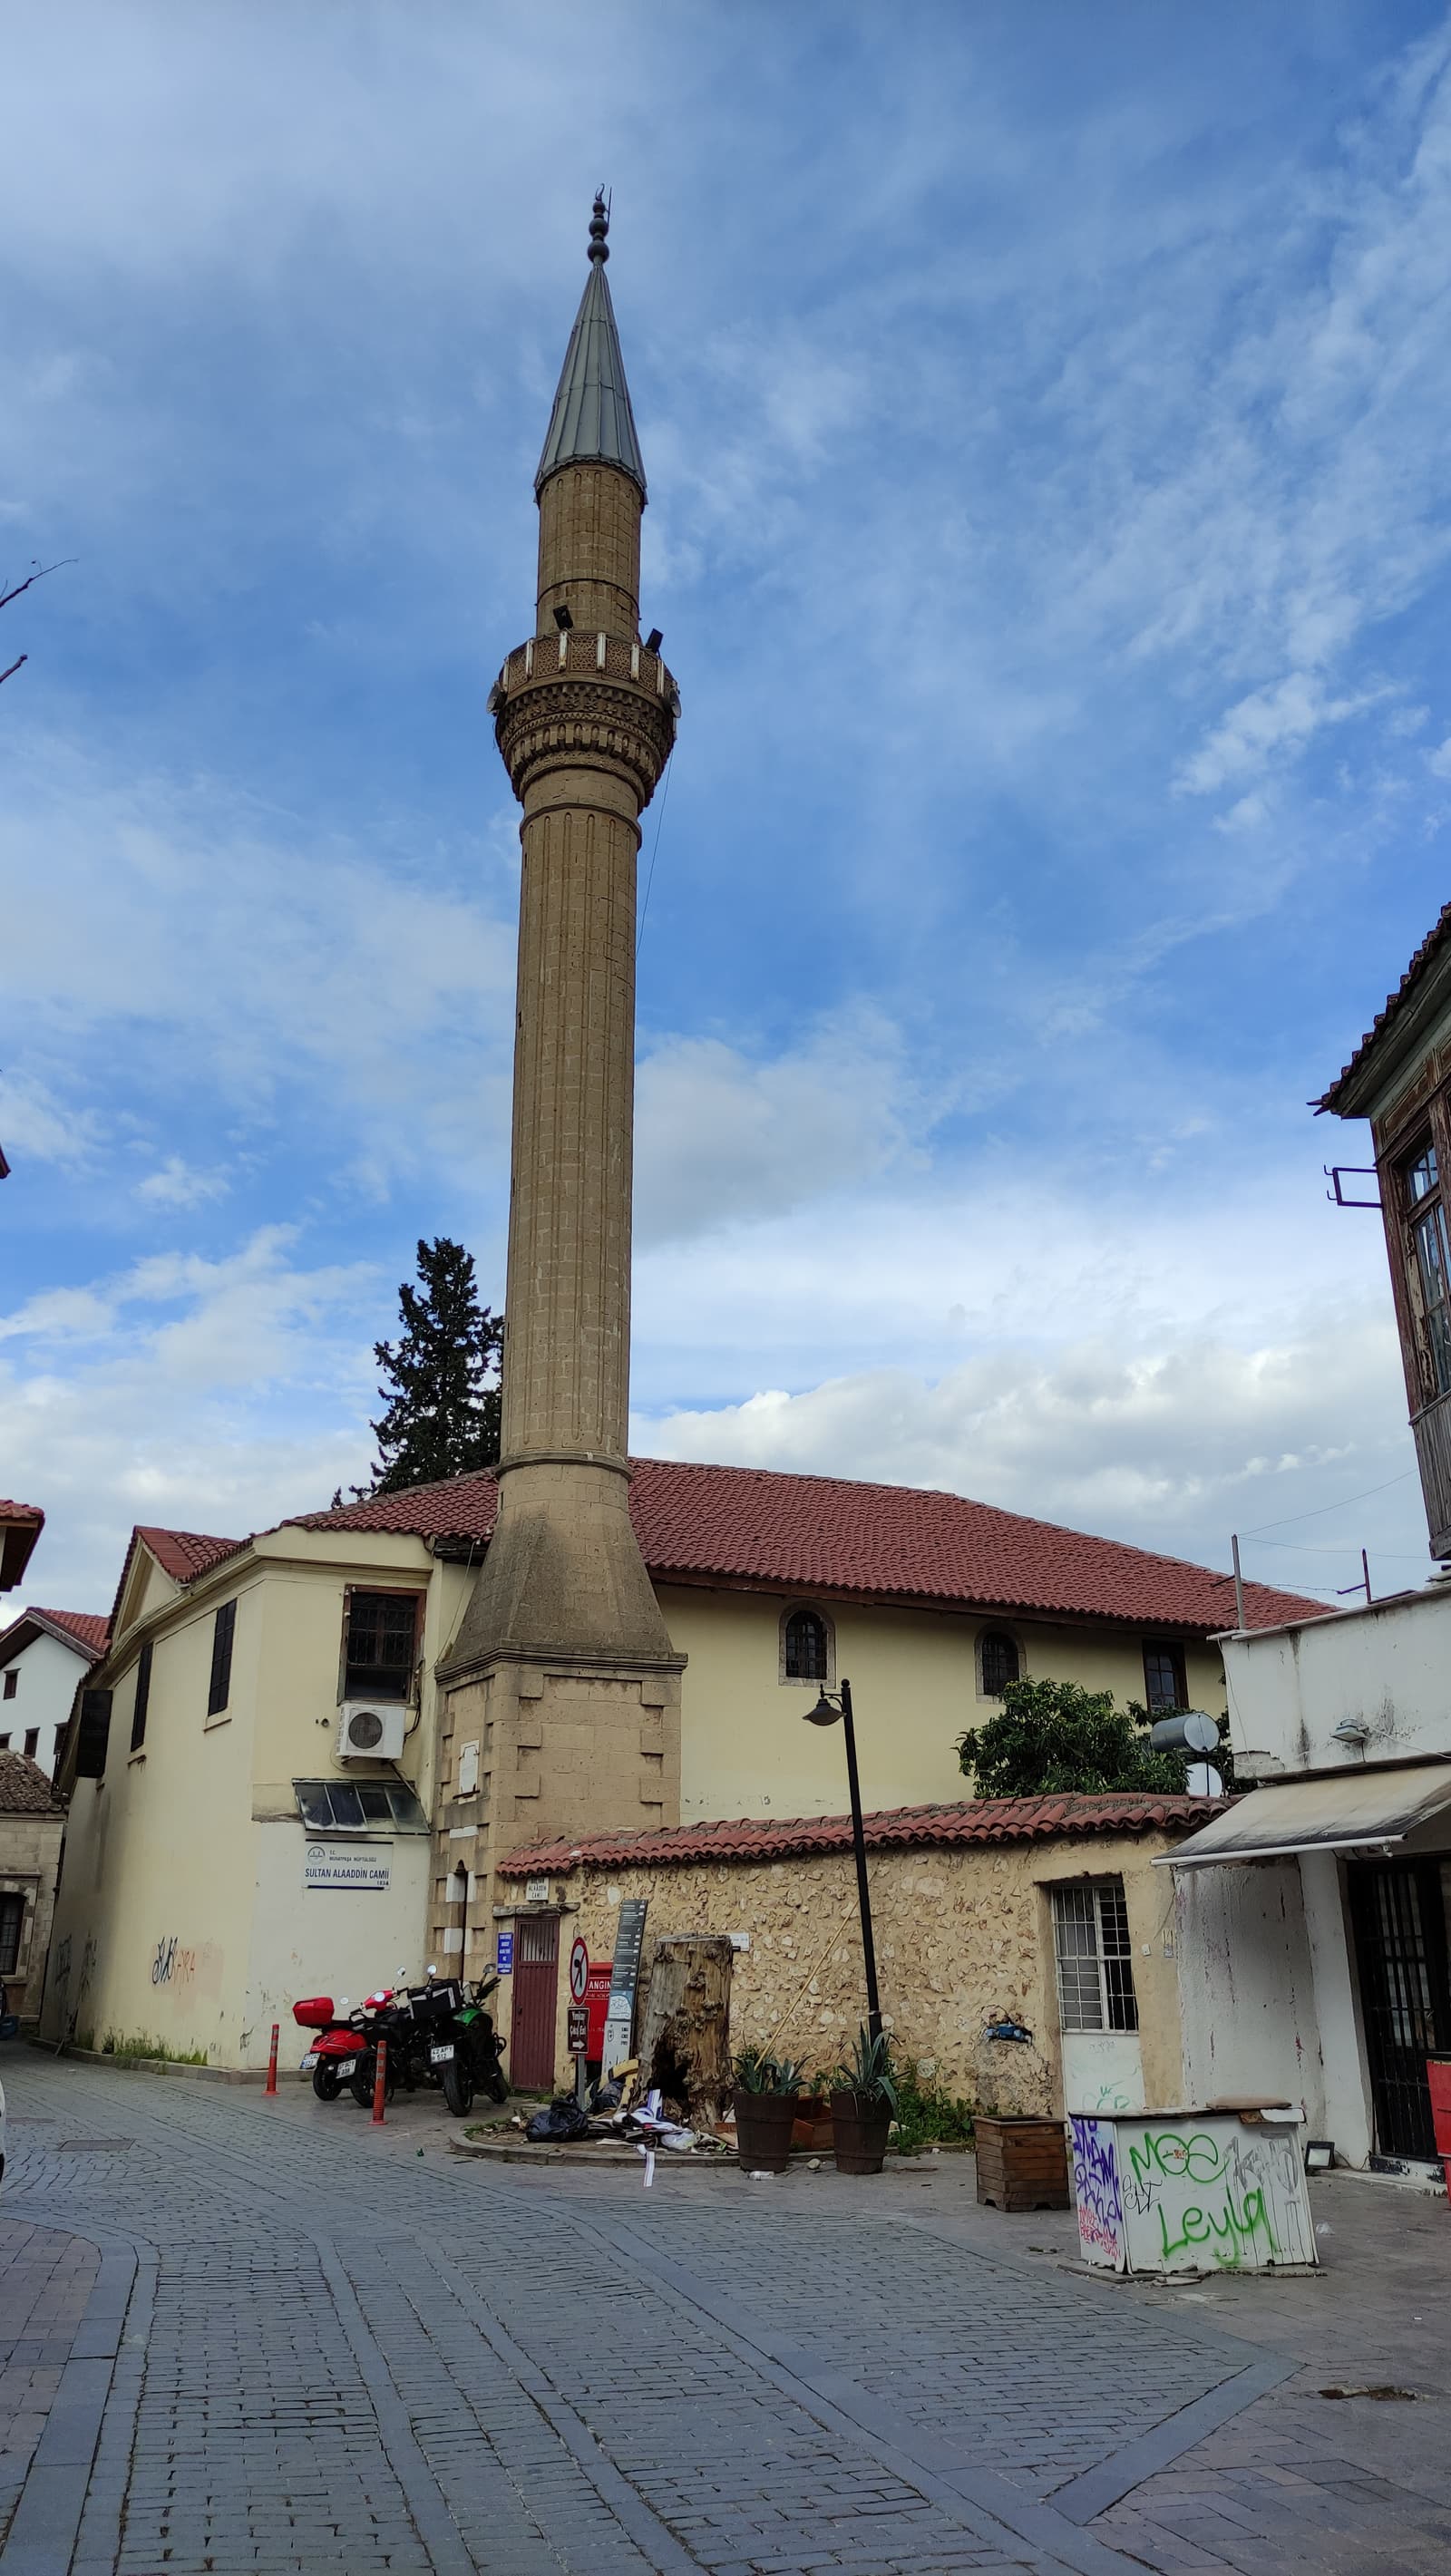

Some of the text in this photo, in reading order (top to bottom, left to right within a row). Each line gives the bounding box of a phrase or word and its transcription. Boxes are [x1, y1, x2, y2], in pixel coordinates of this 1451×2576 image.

[305, 1868, 331, 1878] SULTAN
[333, 1867, 367, 1879] ALAADDİN
[589, 1980, 611, 1990] ANGIN
